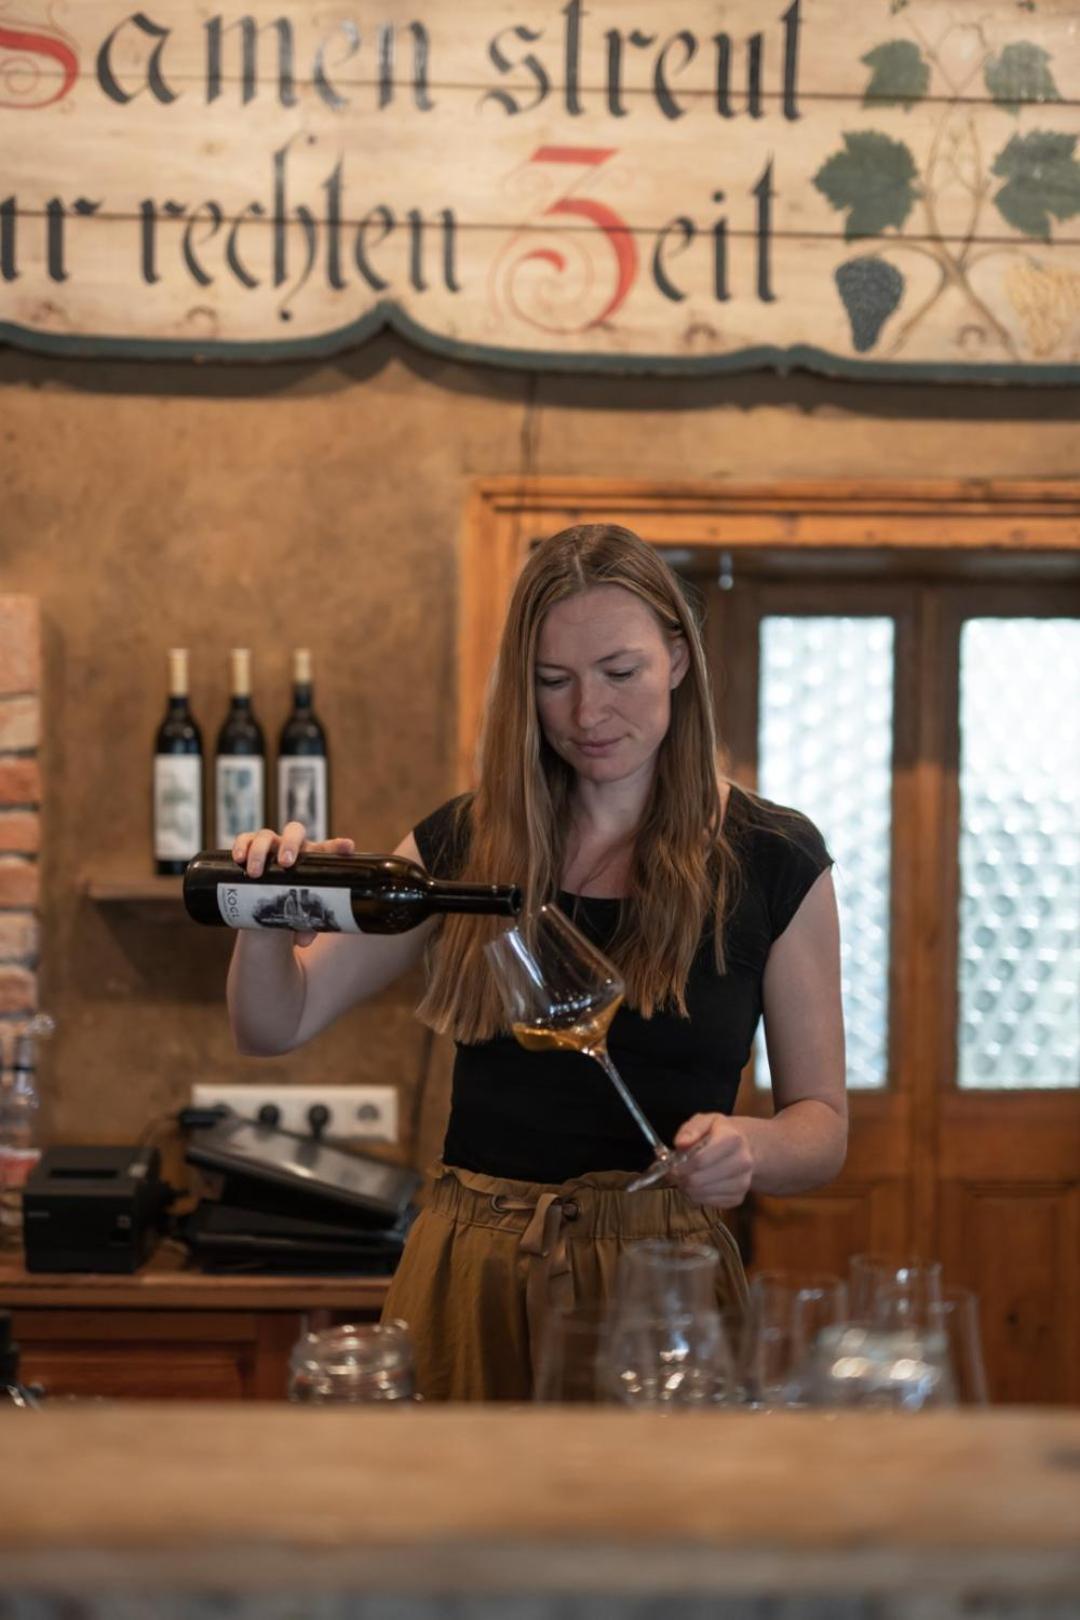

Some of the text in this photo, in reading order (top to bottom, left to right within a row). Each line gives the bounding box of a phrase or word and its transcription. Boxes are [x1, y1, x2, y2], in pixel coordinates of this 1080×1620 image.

[477, 0, 806, 121] streut
[139, 133, 462, 322] rechten
[488, 145, 780, 336] Zeit
